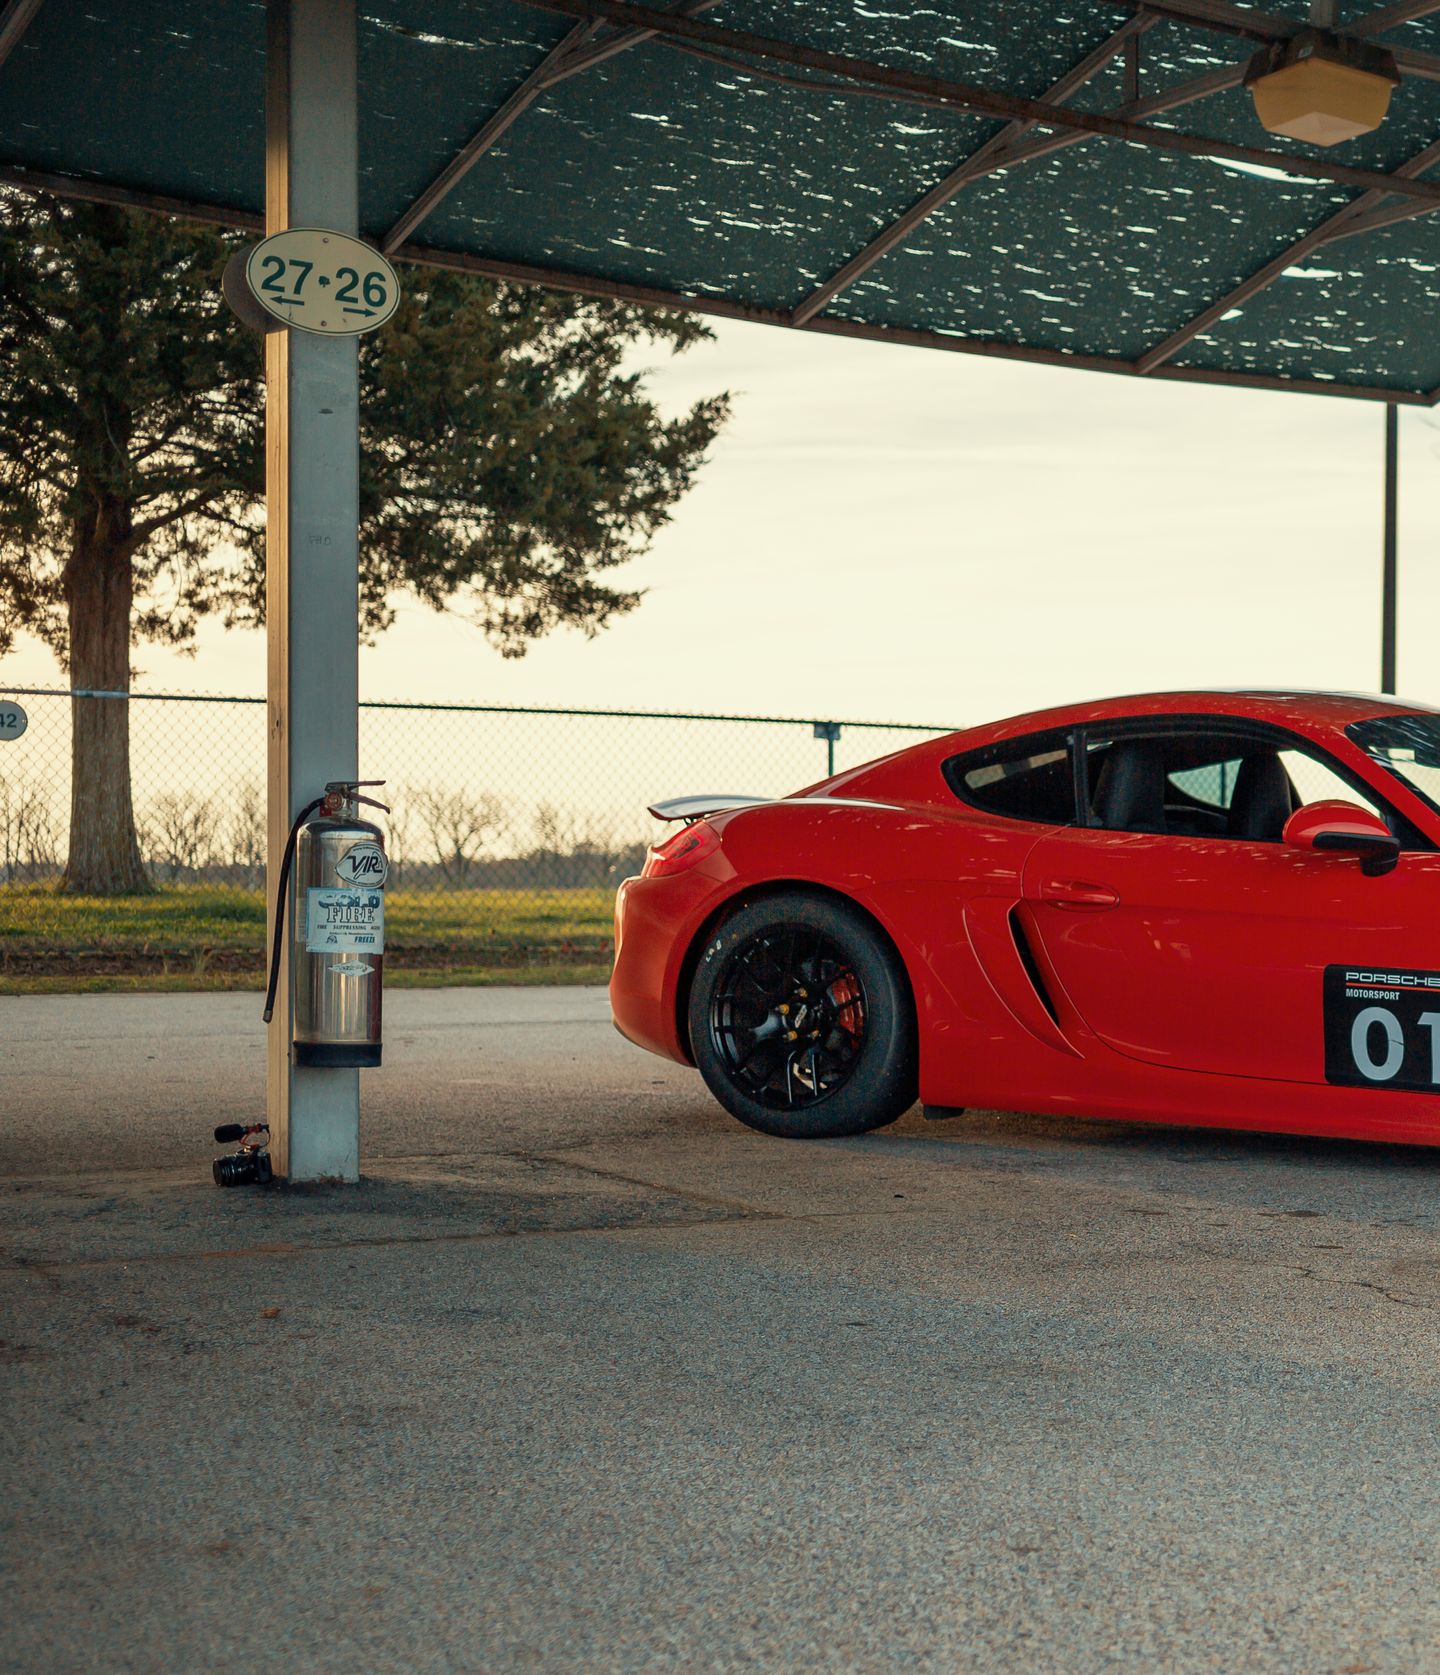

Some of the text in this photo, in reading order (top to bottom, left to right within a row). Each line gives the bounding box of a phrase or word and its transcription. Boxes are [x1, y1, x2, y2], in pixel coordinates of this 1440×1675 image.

[260, 255, 387, 308] 27 26
[327, 906, 374, 924] FIRE
[1345, 988, 1400, 1000] MOTORSPORT
